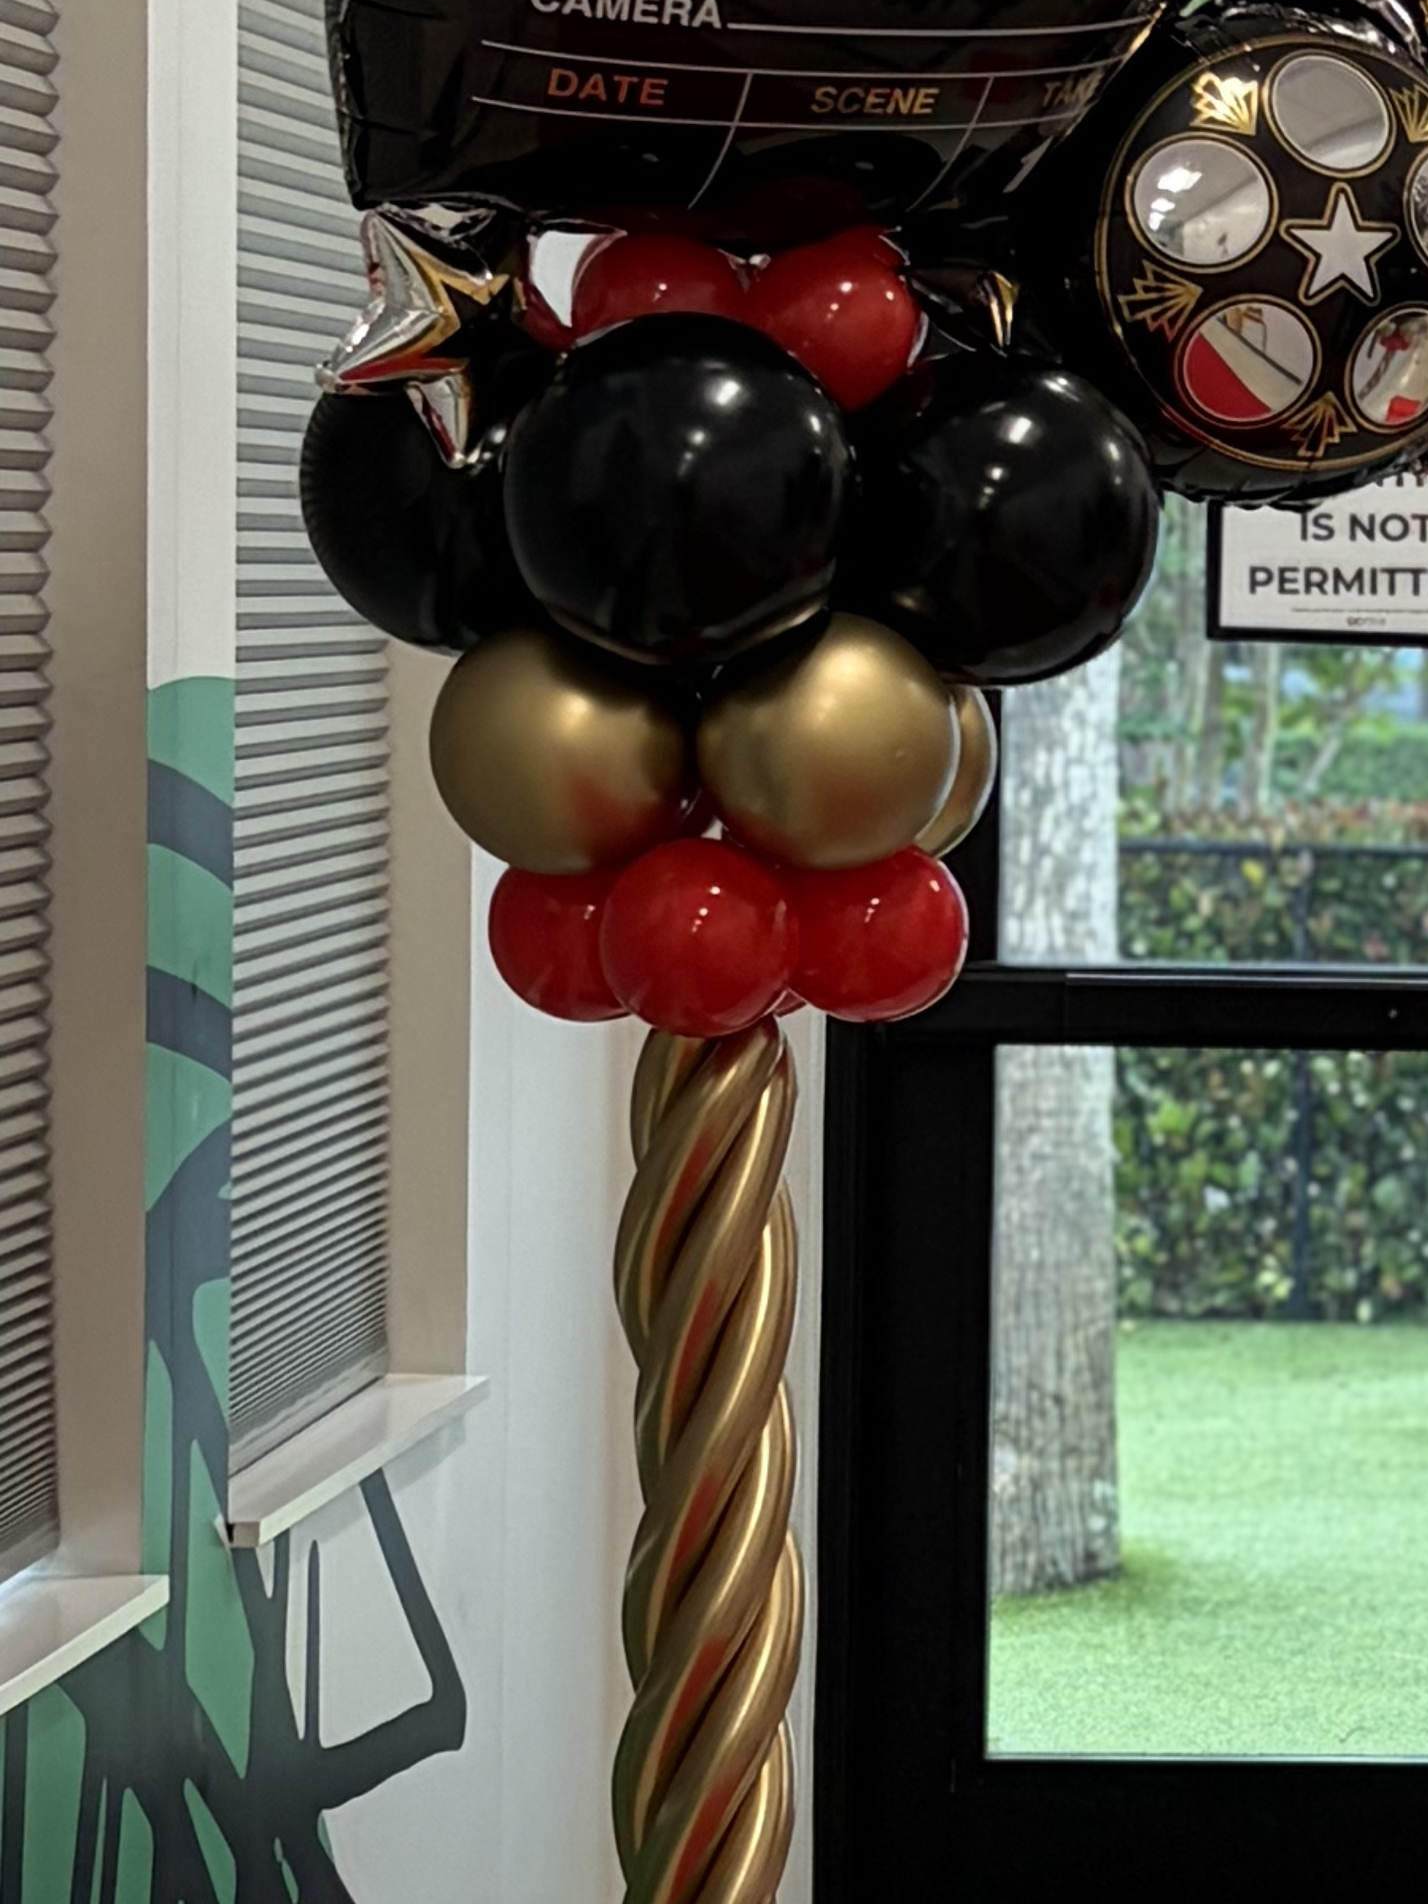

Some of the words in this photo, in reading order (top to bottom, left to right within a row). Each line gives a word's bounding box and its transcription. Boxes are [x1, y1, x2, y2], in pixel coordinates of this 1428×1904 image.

[546, 67, 669, 107] DATE
[810, 85, 940, 117] SCENE
[1299, 512, 1336, 543] IS
